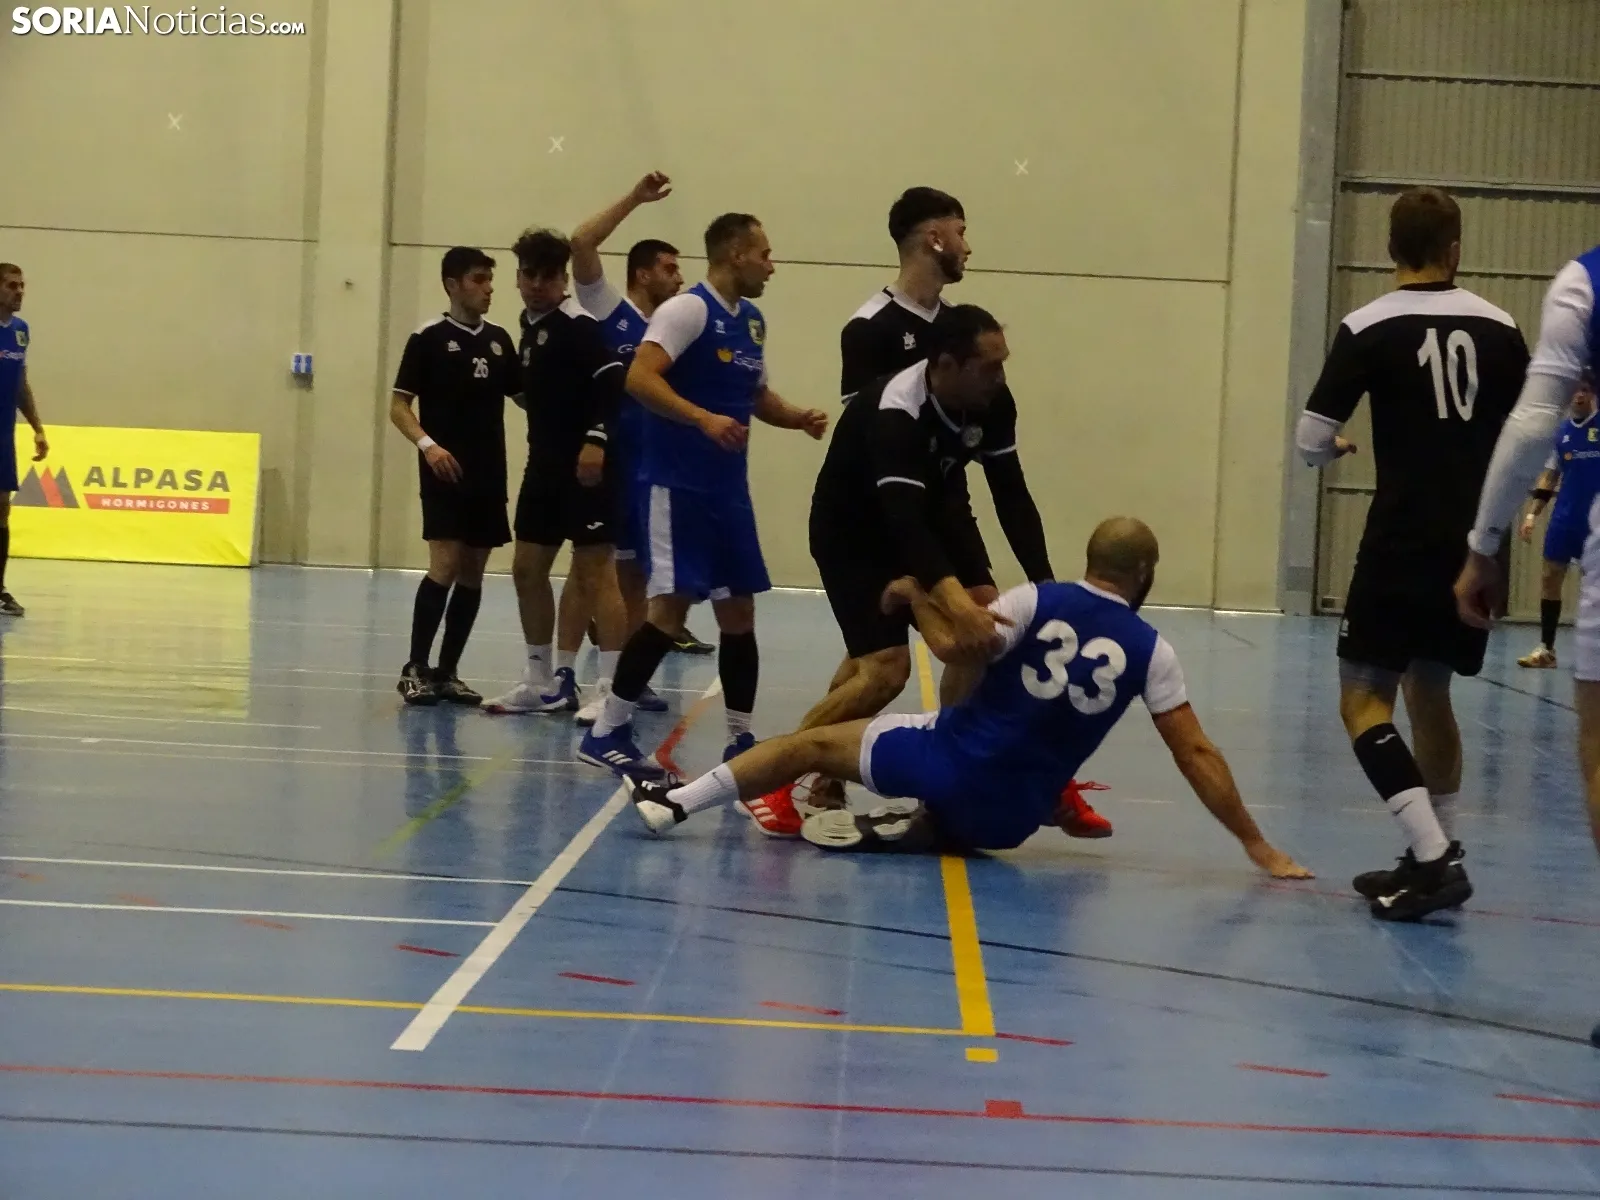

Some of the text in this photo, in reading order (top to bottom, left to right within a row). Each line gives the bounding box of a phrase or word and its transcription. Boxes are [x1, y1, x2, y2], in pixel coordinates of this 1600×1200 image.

[472, 357, 489, 379] 26
[1416, 327, 1479, 422] 10
[83, 465, 231, 492] ALPASA
[101, 497, 211, 511] HORMIGONES
[1021, 618, 1127, 715] 33
